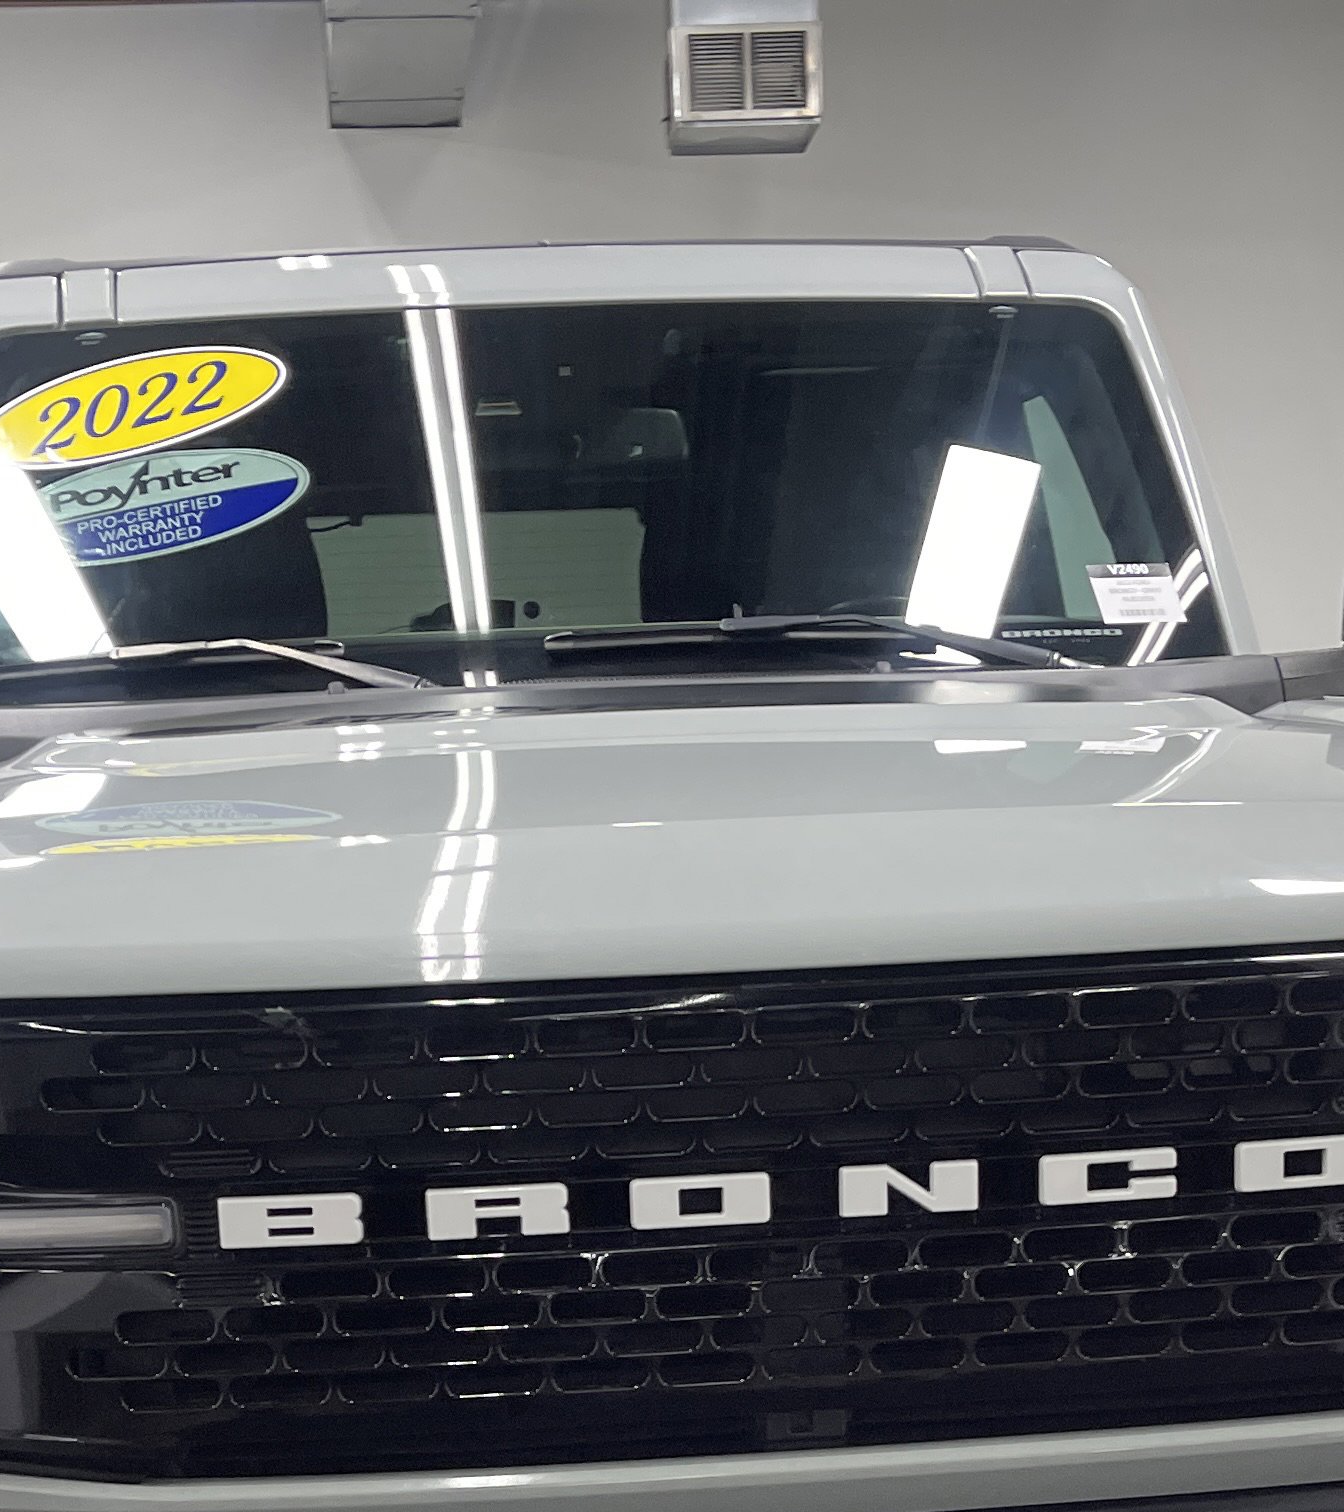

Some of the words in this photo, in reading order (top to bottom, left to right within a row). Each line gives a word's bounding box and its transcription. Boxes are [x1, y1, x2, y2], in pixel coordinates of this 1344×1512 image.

[32, 360, 228, 456] 2022
[49, 460, 241, 514] Poynter
[76, 494, 223, 535] PRO-CERTIFIED
[97, 512, 205, 544] WARRANTY
[105, 525, 203, 557] INCLUDED
